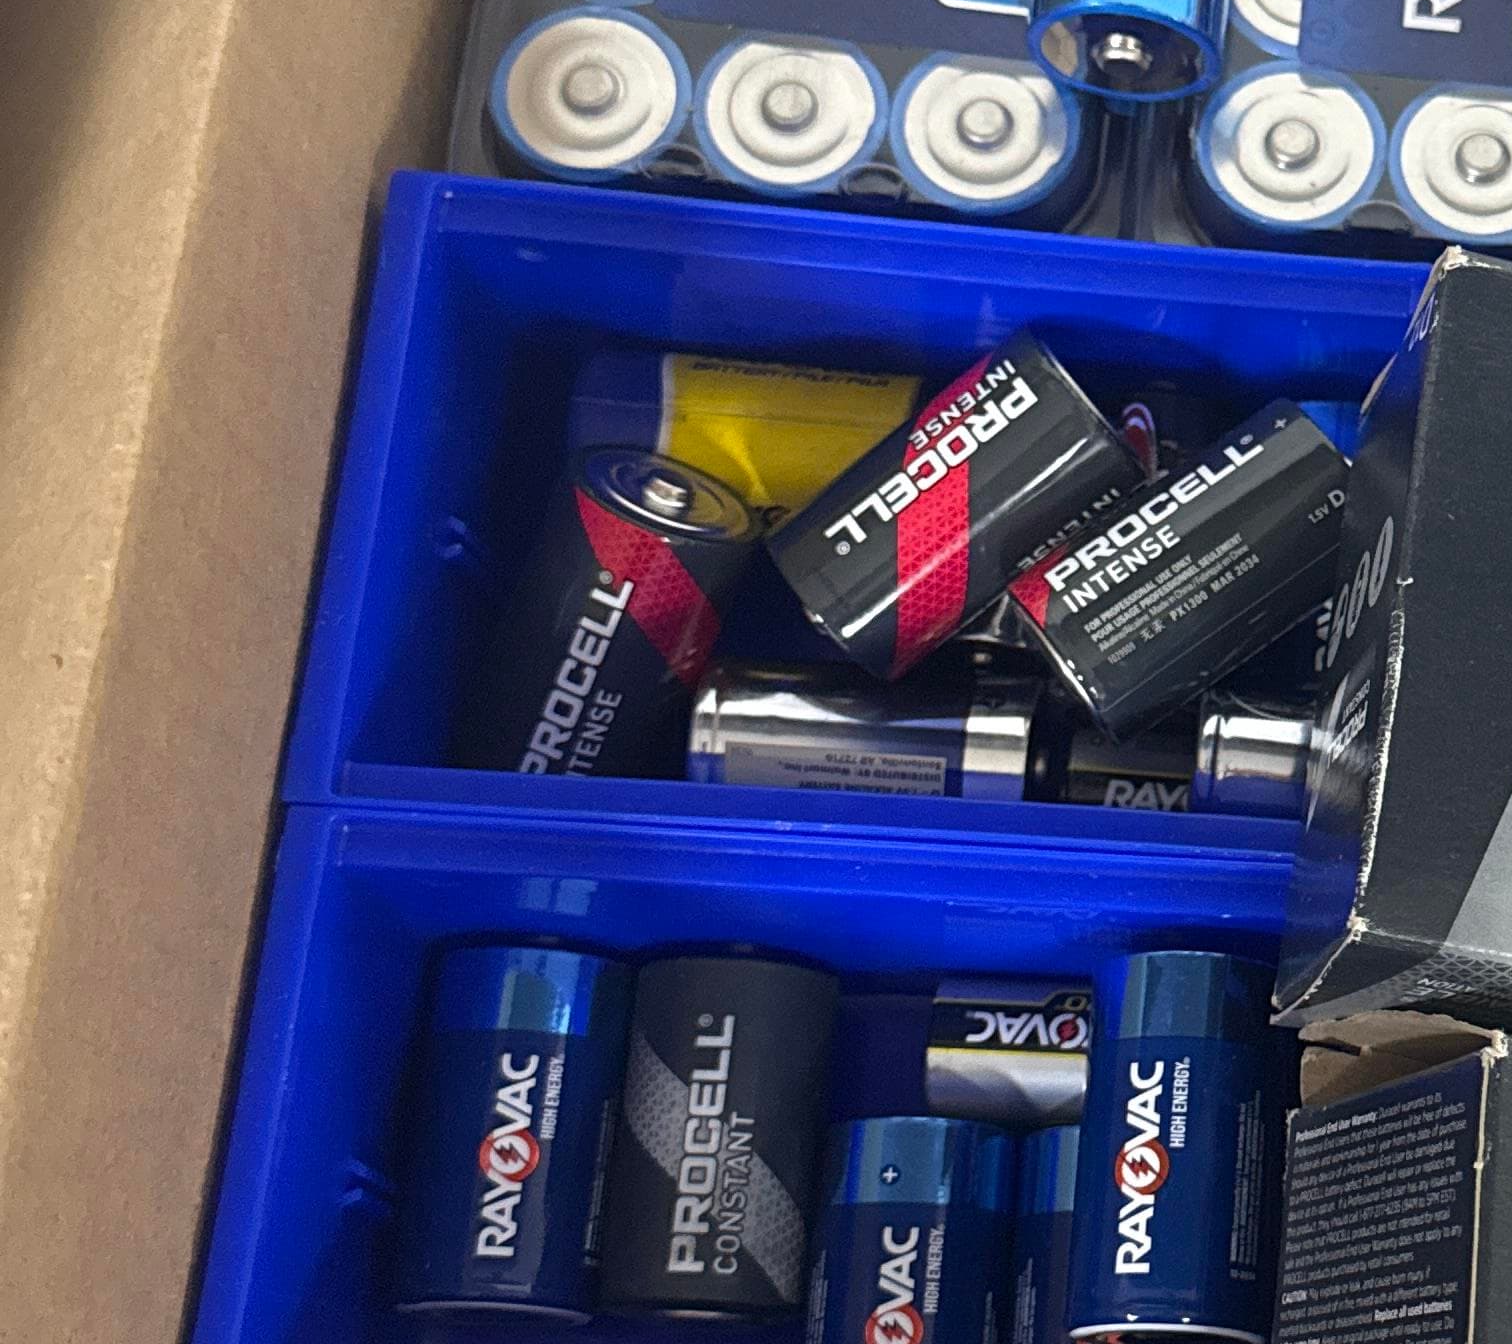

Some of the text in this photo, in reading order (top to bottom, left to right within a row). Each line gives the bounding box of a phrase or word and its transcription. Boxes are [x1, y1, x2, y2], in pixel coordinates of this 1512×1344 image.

[908, 359, 1016, 451] INTENSE
[823, 377, 1039, 544] PROCELL
[1329, 489, 1346, 509] D
[1044, 444, 1265, 592] PROCELL
[1062, 524, 1182, 613] INTENSE
[1083, 554, 1194, 633] FOR PROFESSIONAL USE ONLY
[1090, 622, 1115, 642] POUR
[1112, 603, 1142, 627] USAGE
[1196, 532, 1244, 568] SEULEMENT
[1209, 570, 1236, 593] MAR
[1232, 553, 1261, 577] 2034
[516, 580, 634, 776] PROCELL
[565, 688, 623, 778] TENSE
[804, 765, 849, 776] Walmart
[872, 769, 940, 782] DISTRIBUTED
[965, 1010, 1093, 1050] OVAC
[539, 1055, 566, 1140] HIGH ENERGY
[1169, 1061, 1190, 1148] HIGH ENERGY
[476, 1052, 540, 1258] RAYOVAC
[666, 1014, 735, 1273] PROCELL
[1115, 1060, 1165, 1276] RAYOVAC
[712, 1111, 755, 1275] CONSTANT
[924, 1226, 945, 1314] HIGH ENERGY
